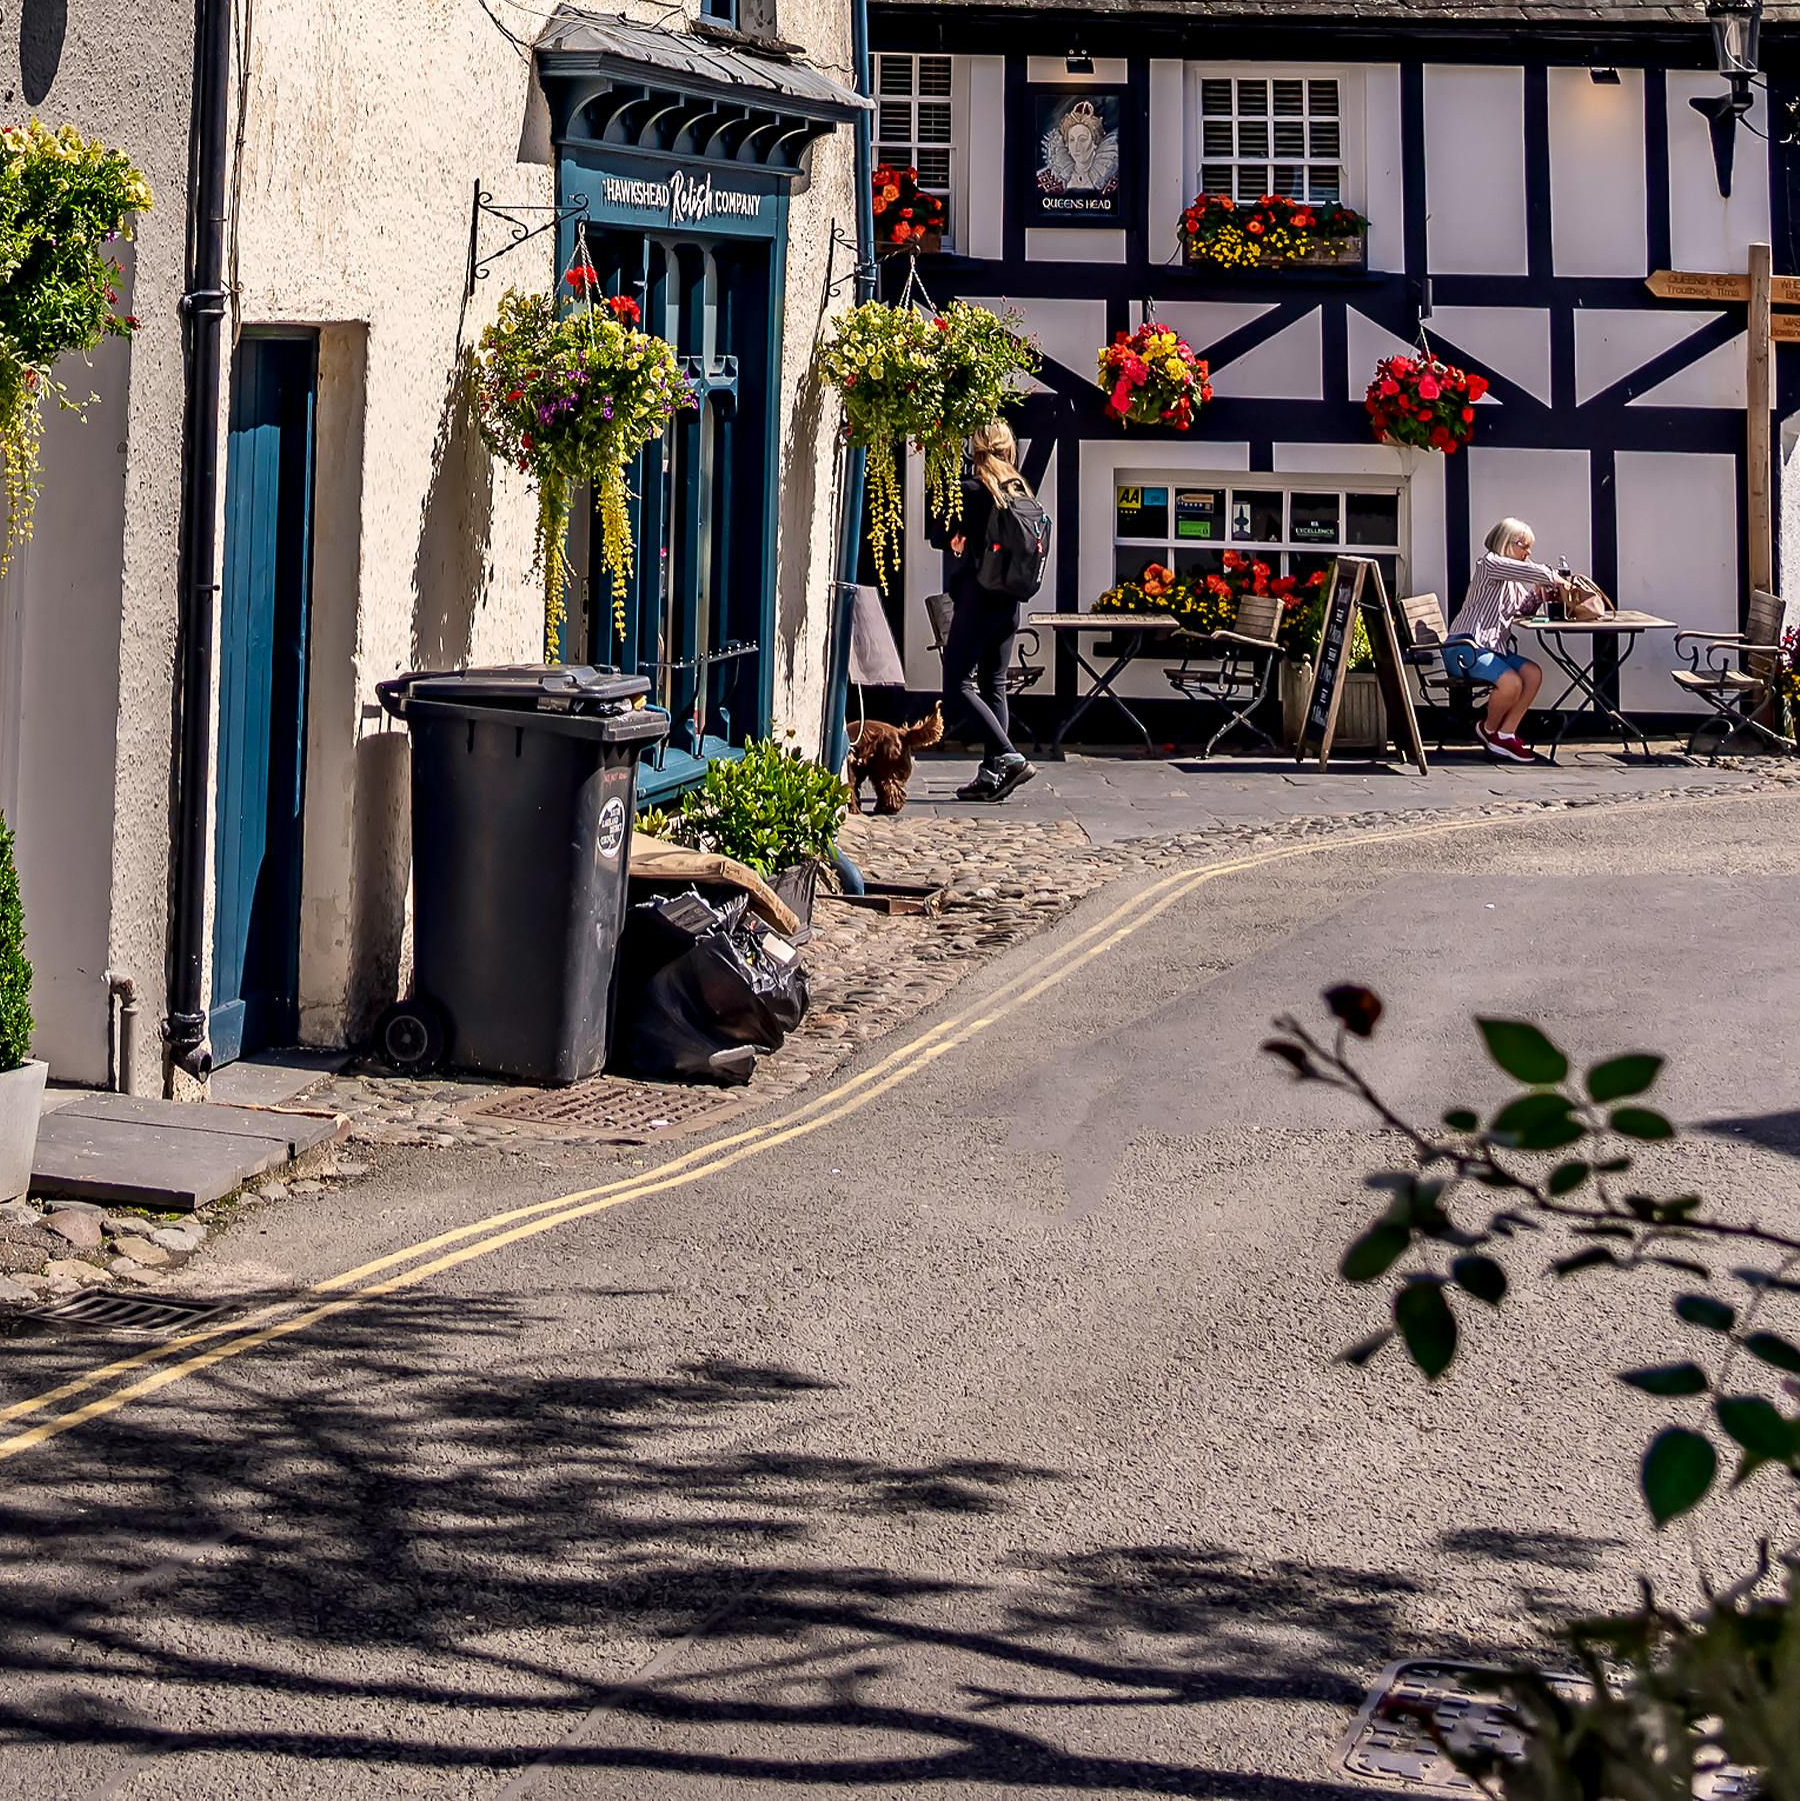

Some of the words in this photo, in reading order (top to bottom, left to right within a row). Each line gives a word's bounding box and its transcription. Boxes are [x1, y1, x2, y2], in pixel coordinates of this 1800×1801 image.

[606, 177, 670, 207] HAWKSHEAD
[670, 169, 714, 223] Relish
[714, 190, 761, 216] COMPANY
[1042, 197, 1084, 210] QUEENS
[1085, 198, 1112, 210] HEAD
[1667, 274, 1708, 285] QUEENS
[1710, 277, 1737, 287] HEAD
[1666, 284, 1713, 297] Troutbeck
[1119, 488, 1139, 504] AA
[1295, 527, 1335, 535] EXCELLENCE
